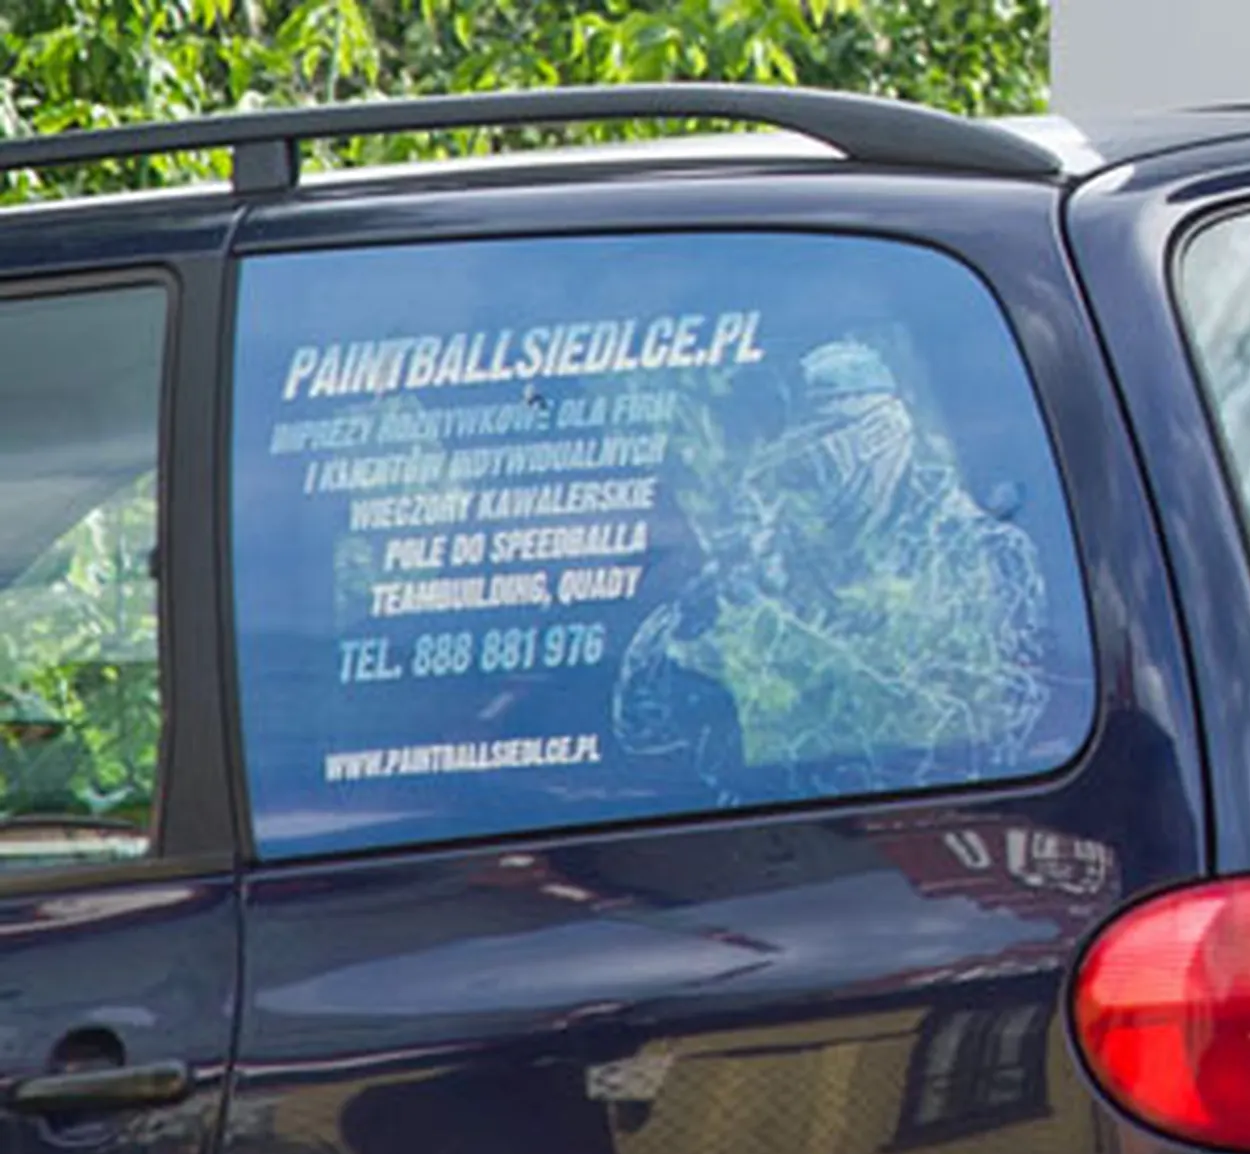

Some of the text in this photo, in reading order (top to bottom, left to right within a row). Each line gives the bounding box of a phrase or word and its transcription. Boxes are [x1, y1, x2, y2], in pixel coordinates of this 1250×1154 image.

[283, 310, 766, 400] PAINTBALLSIEDLCE.PL
[556, 396, 607, 429] DLA
[303, 460, 318, 494] I
[477, 477, 656, 519] KAWALERSKIE
[383, 520, 648, 571] POLE DO SPEEDBALLA
[370, 566, 643, 618] TEAMBUILDING, QUADY
[339, 623, 605, 684] TEL. 888 881 976
[325, 733, 602, 782] WWW.PAINTBALLSIEDLCE.PL
